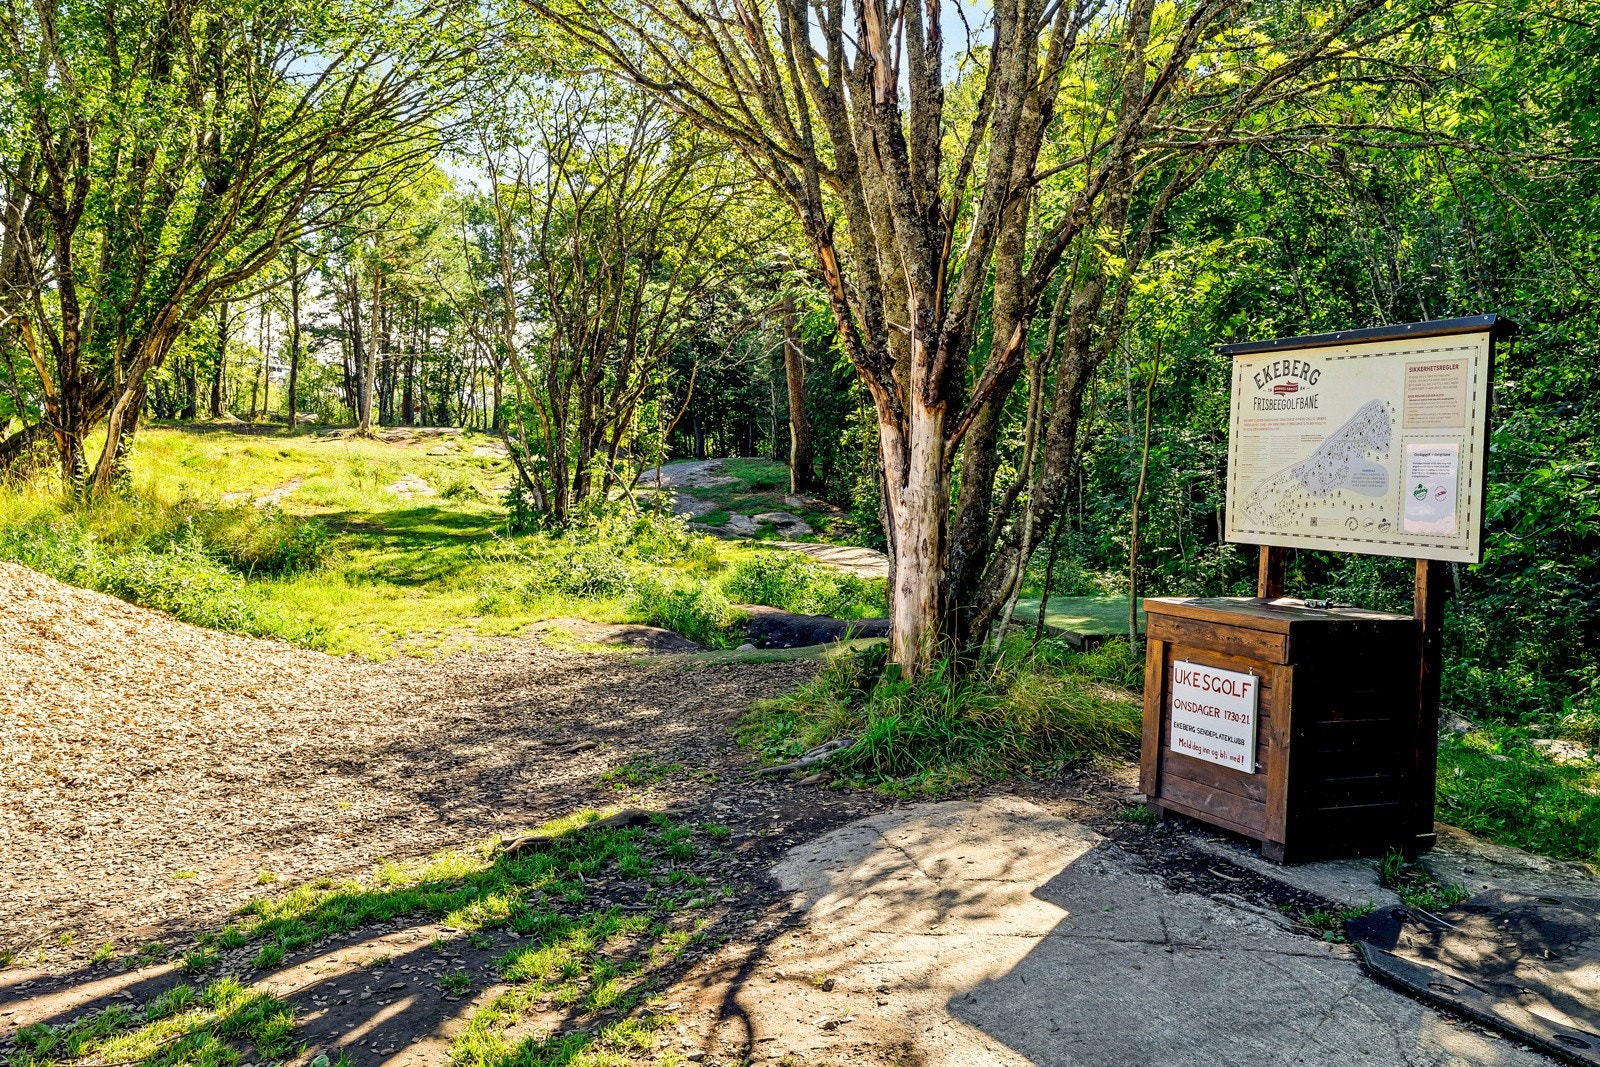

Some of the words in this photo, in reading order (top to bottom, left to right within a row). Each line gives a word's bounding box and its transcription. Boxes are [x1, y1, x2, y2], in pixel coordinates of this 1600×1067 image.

[1253, 360, 1321, 390] EKEBERG
[1409, 364, 1459, 373] SIKKERHETSREGLER
[1253, 394, 1319, 411] FRISBEEGOLFBANE
[1174, 668, 1252, 698] UKESGOLF
[1173, 698, 1220, 718] ONSDAGER
[1173, 721, 1196, 733] EKEBERG
[1196, 727, 1246, 746] SENDEPLATEKLUBB
[1178, 737, 1192, 749] Meld
[1191, 743, 1202, 755] deg
[1211, 750, 1219, 760] og
[1219, 750, 1228, 760] bli
